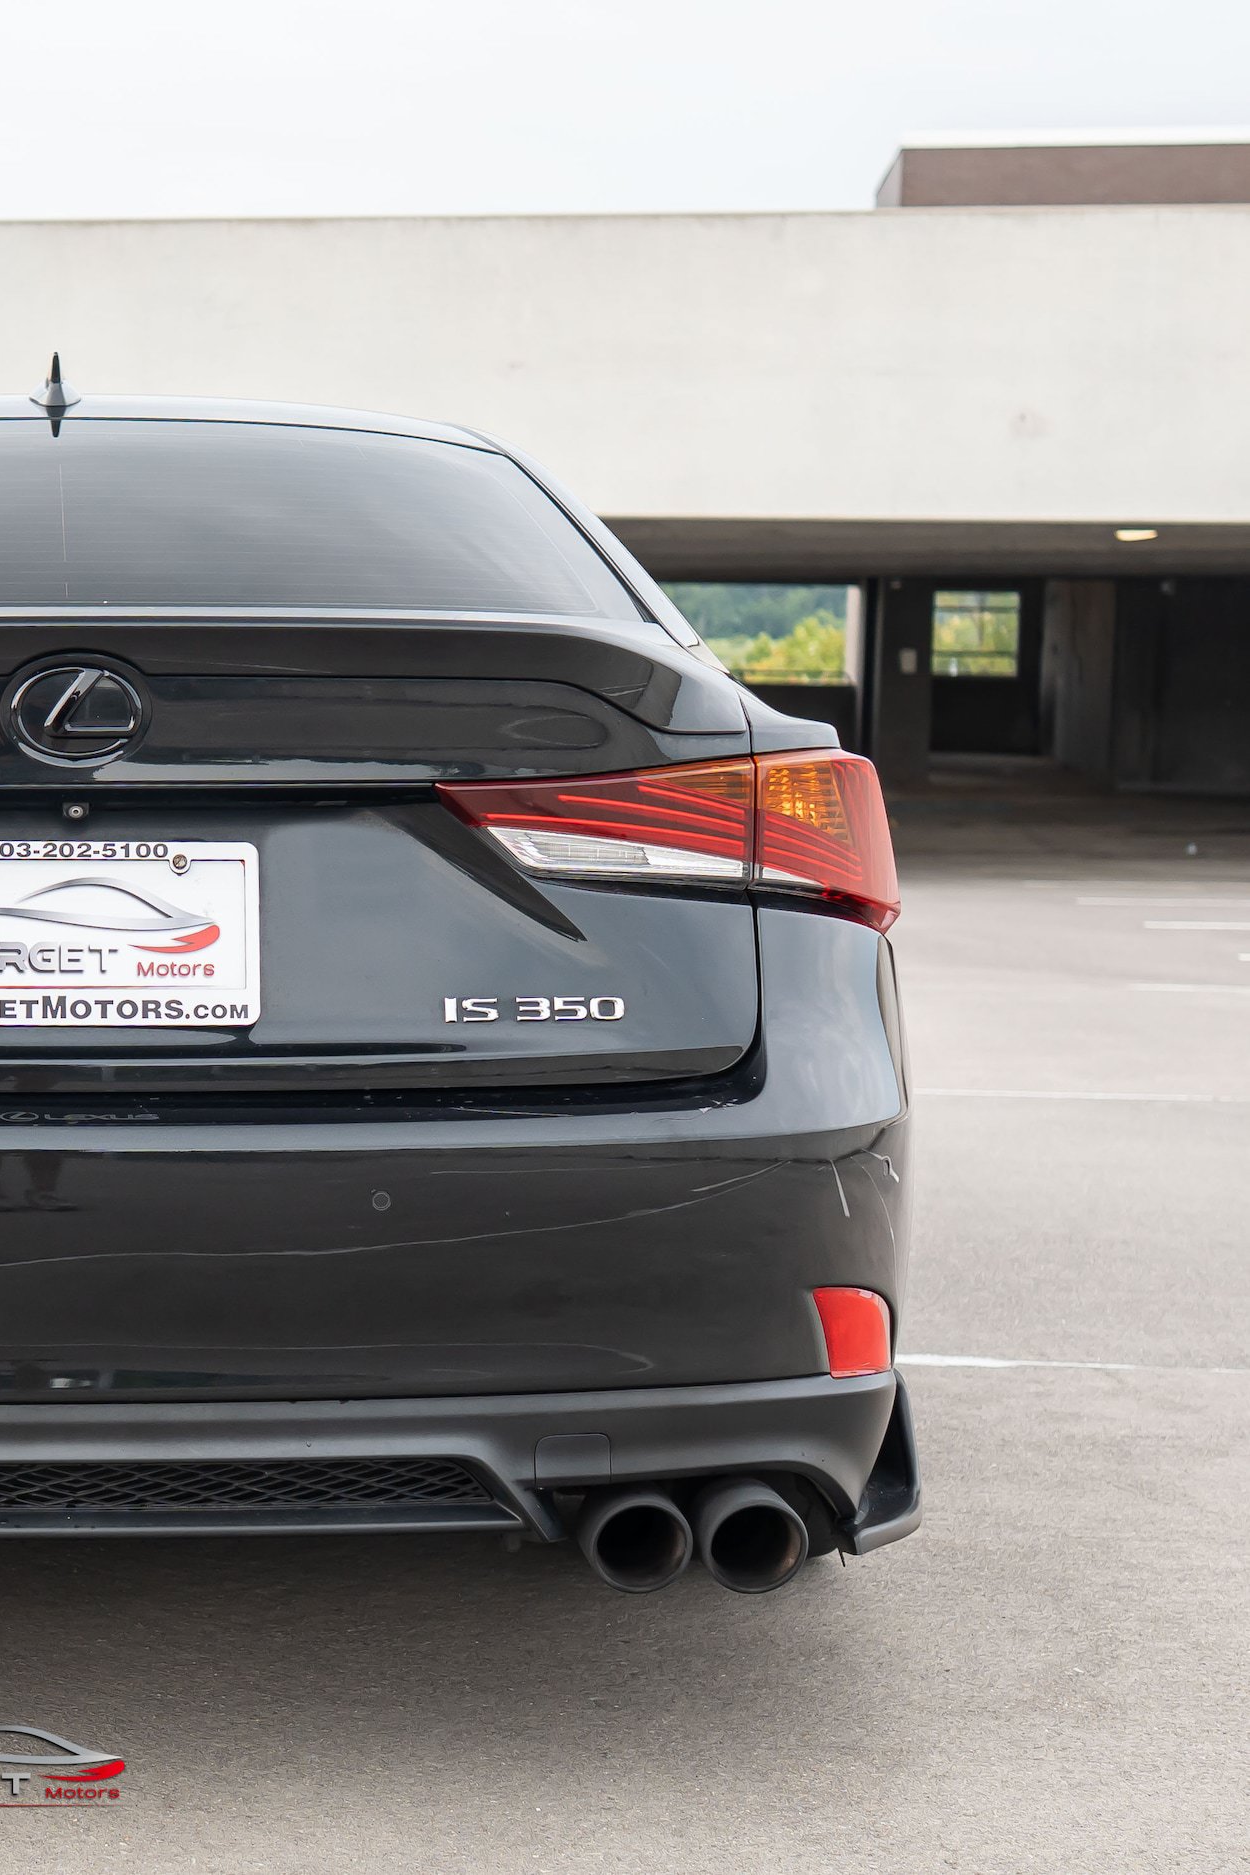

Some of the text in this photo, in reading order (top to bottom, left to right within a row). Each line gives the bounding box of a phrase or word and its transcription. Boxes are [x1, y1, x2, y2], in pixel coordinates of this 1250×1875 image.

[136, 961, 215, 977] Motors
[444, 996, 626, 1023] IS 350
[44, 1112, 160, 1122] LEXUS
